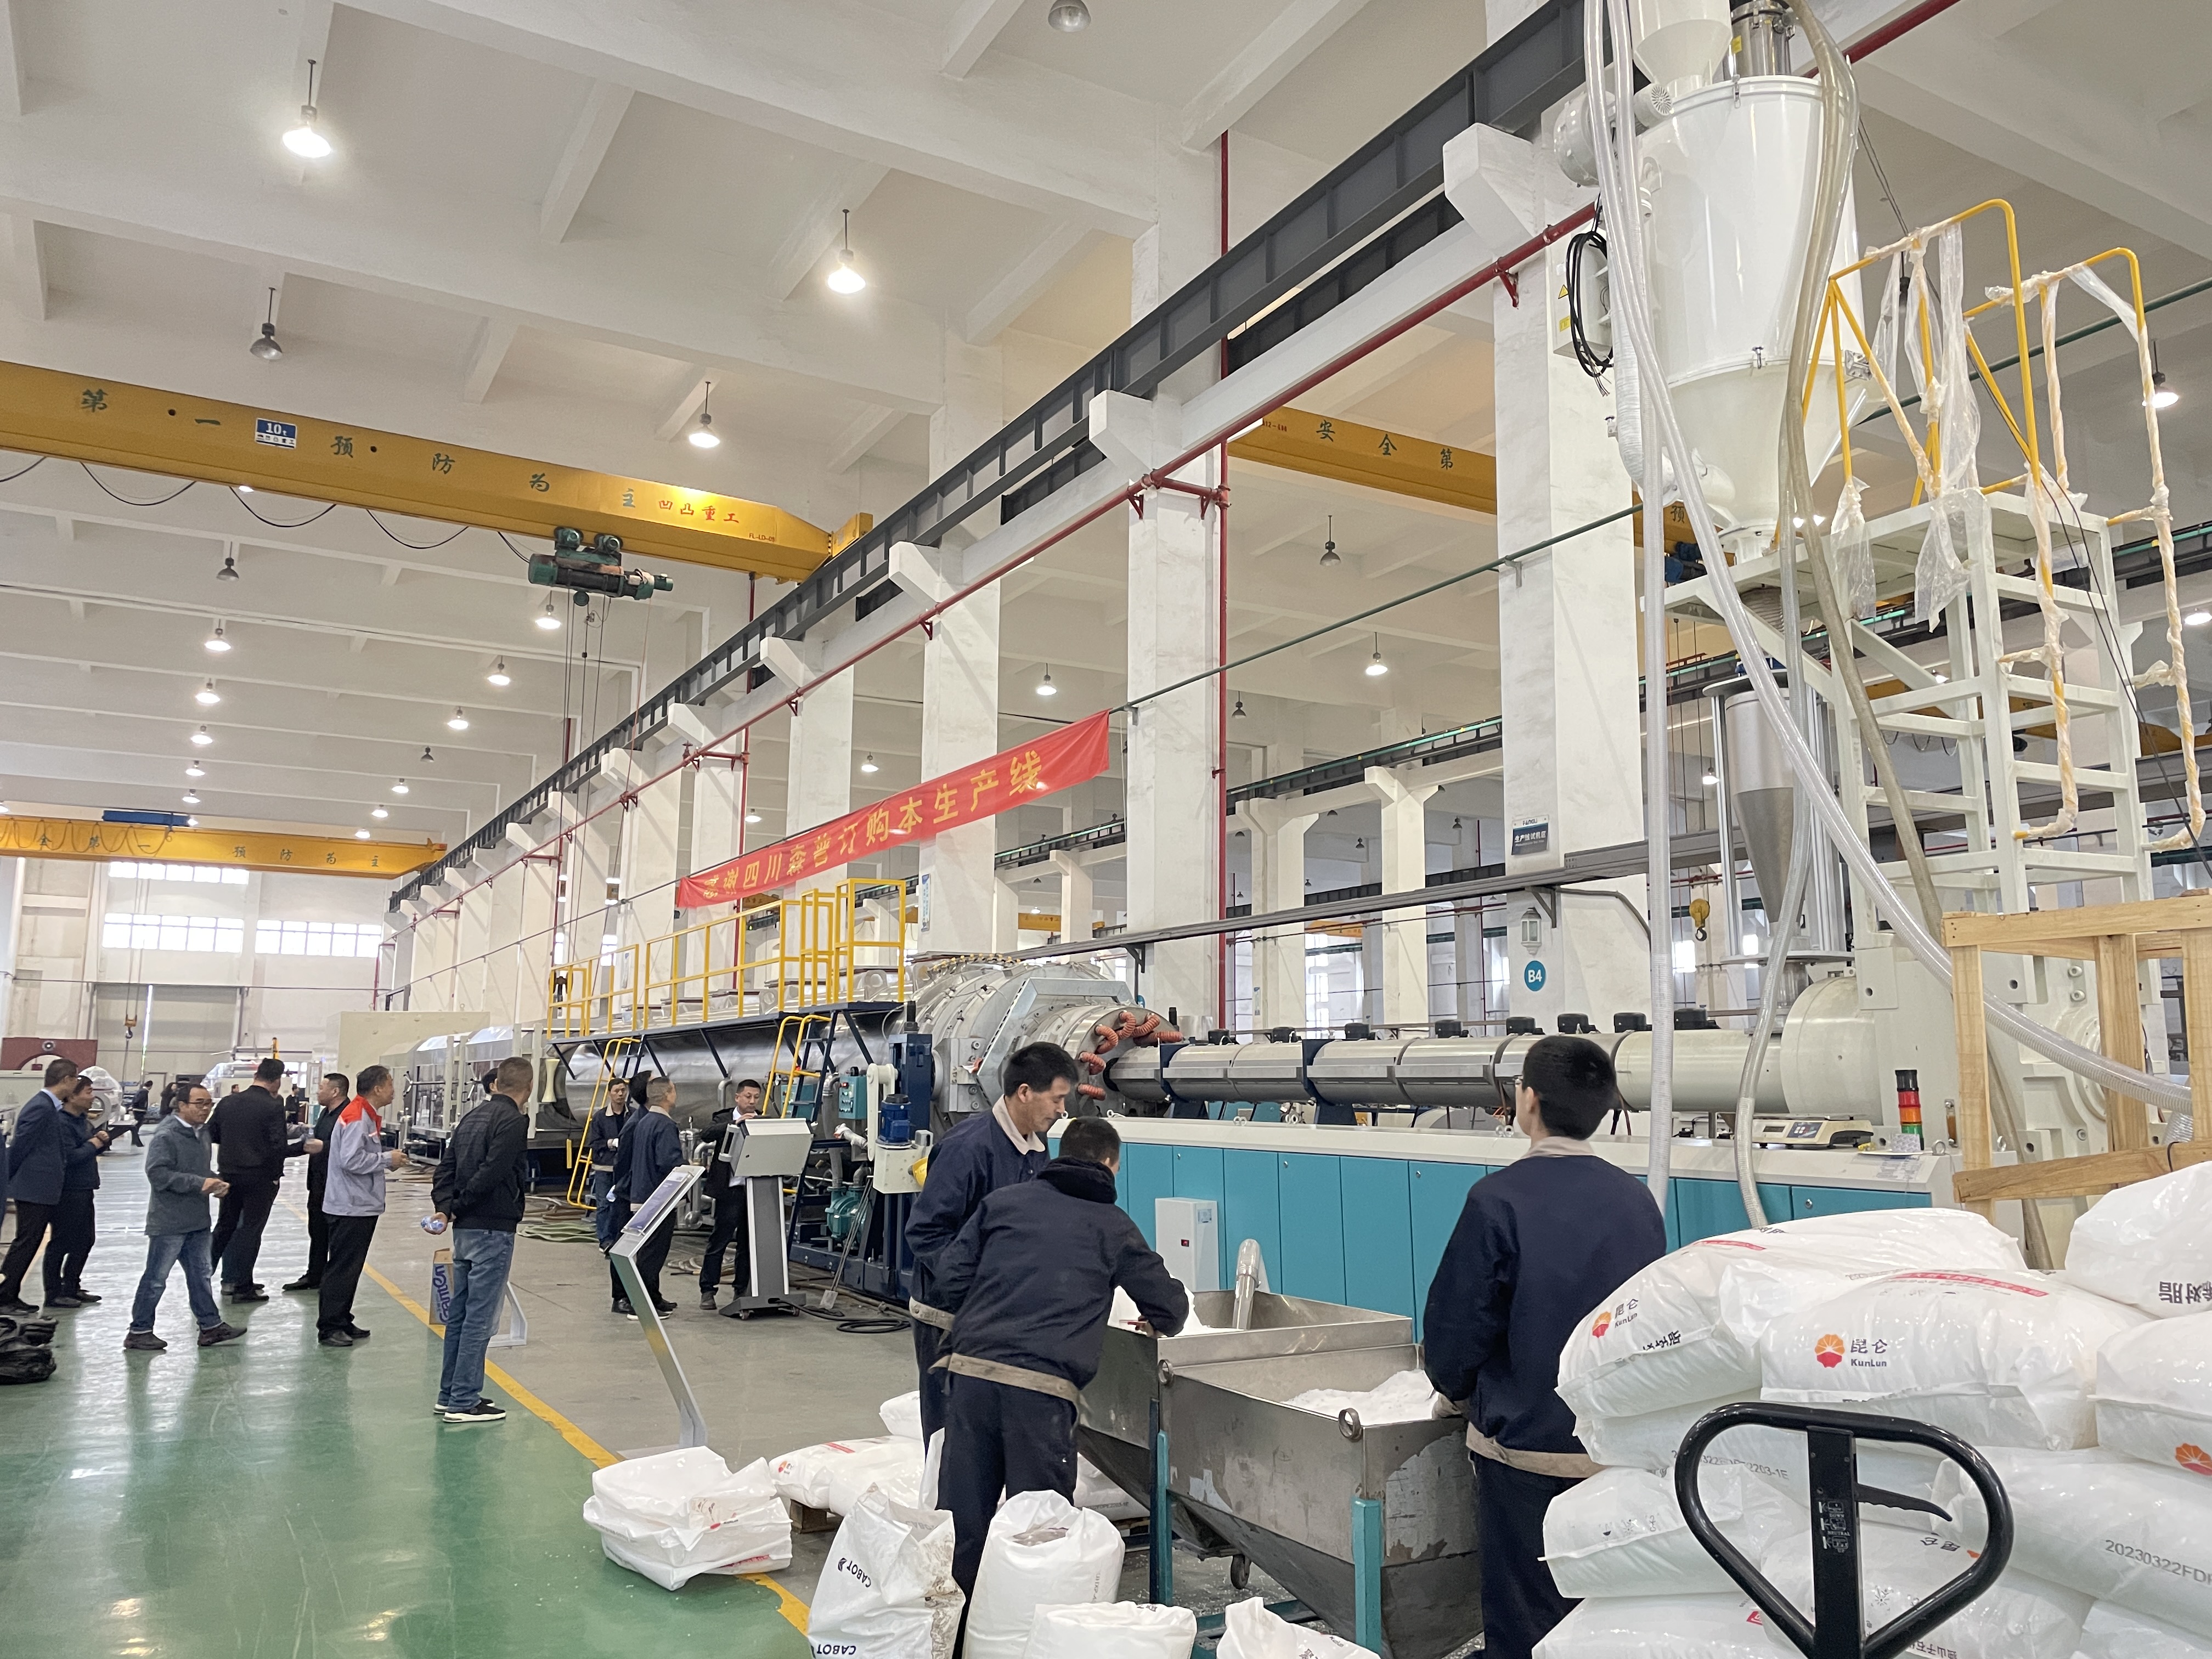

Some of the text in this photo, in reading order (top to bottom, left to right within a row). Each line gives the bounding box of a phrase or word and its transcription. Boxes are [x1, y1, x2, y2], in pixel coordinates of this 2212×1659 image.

[659, 500, 740, 523] 凹凸重工
[1528, 969, 1543, 983] B4
[1615, 1299, 1639, 1319] 昆仑
[1850, 1339, 1888, 1354] 昆仑
[1851, 1358, 1887, 1367] KunLun
[846, 1561, 872, 1588] CABOT
[817, 1644, 857, 1656] CABOT
